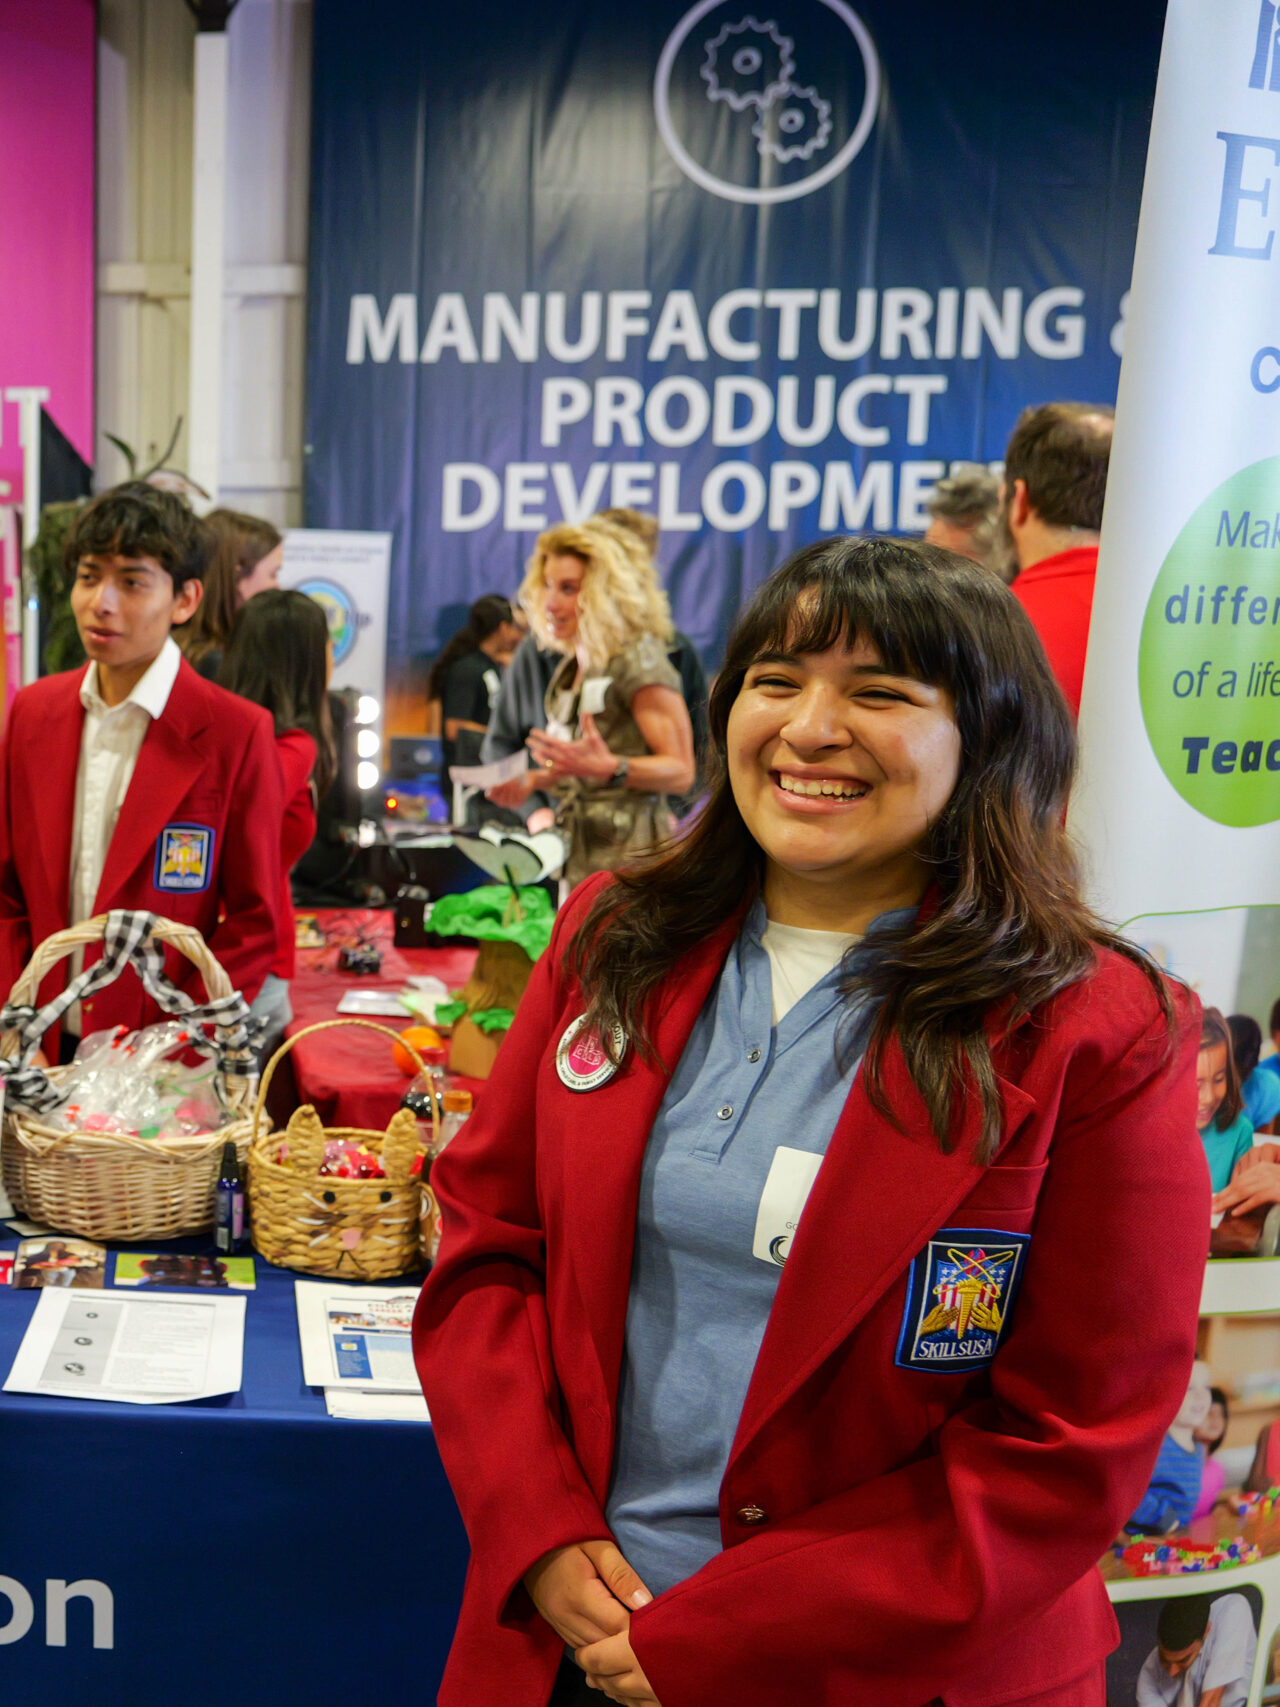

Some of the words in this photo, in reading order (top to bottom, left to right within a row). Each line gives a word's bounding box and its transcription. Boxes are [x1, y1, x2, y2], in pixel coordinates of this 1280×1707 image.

[344, 286, 1087, 365] MANUFACTURING
[540, 374, 948, 449] PRODUCT
[440, 460, 1008, 532] DEVELOPME
[1172, 661, 1212, 698] of
[1216, 669, 1238, 698] a
[919, 1339, 992, 1358] SKILLSUSA
